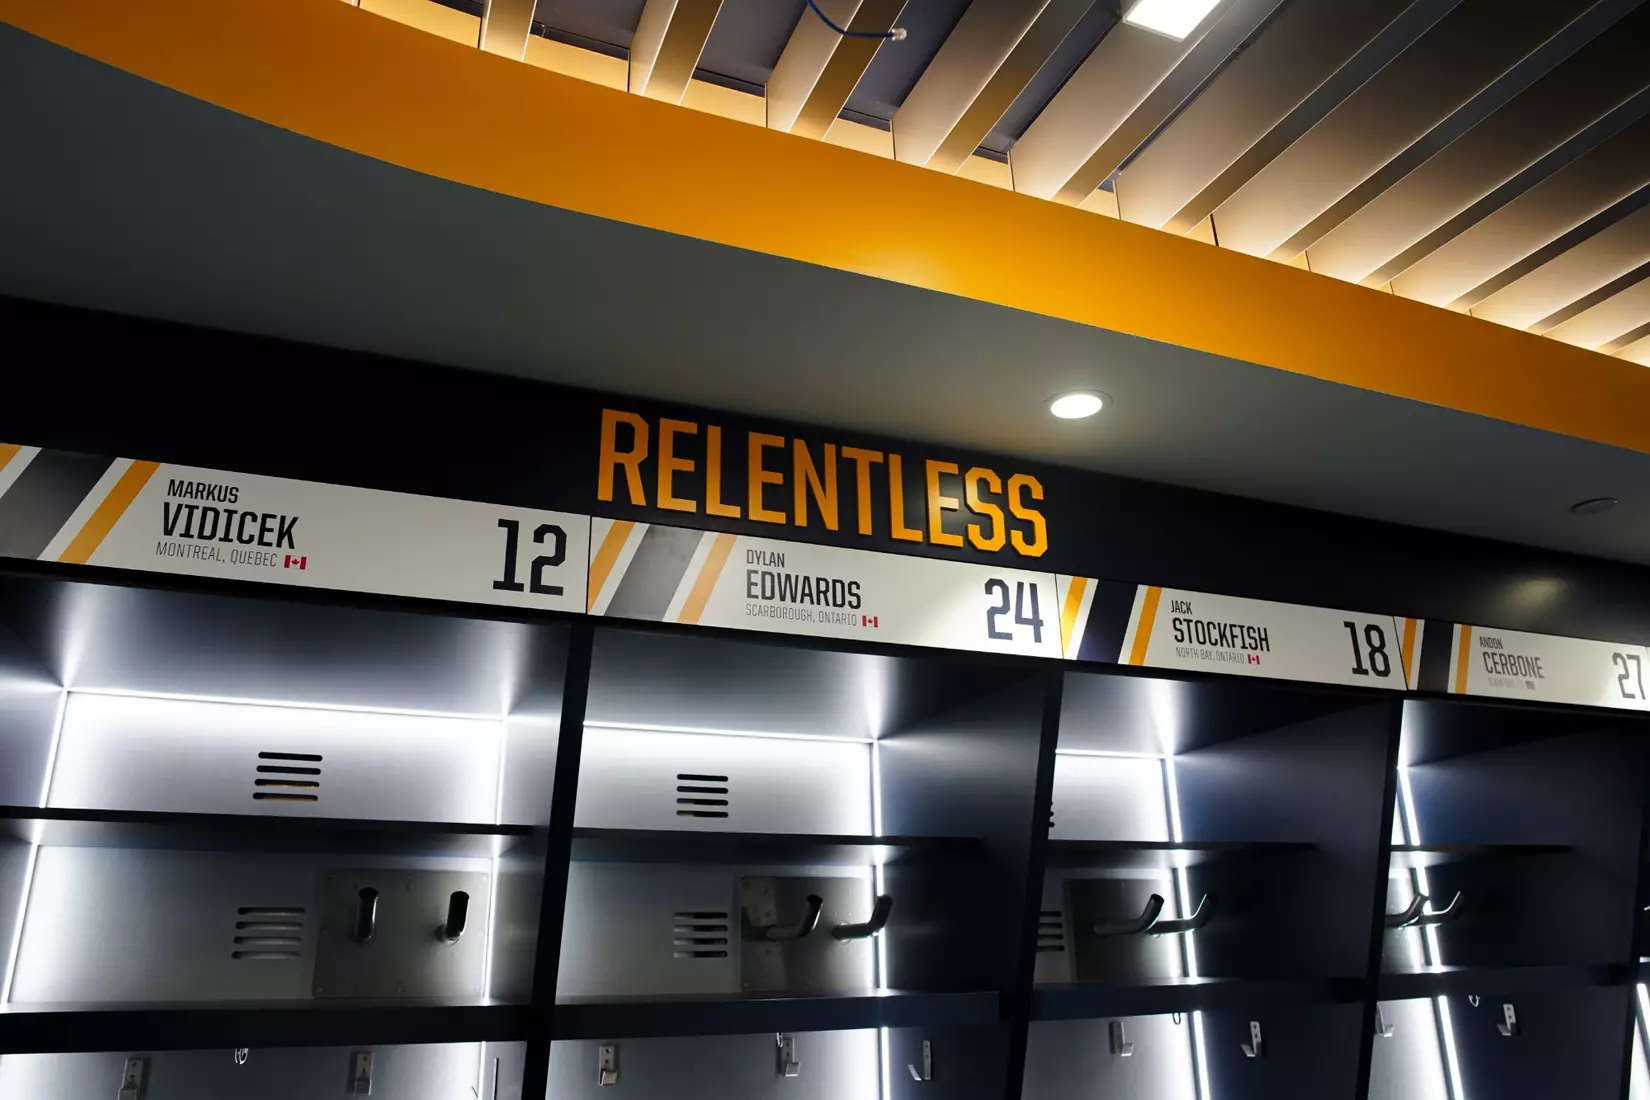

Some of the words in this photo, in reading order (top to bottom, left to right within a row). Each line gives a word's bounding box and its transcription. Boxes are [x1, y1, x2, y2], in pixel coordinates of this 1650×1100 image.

[167, 479, 239, 504] MARKUS
[597, 407, 1048, 558] RELENTLESS
[162, 501, 299, 549] VIDICEK
[155, 541, 226, 564] MONTREAL,
[230, 549, 278, 568] QUEBEC
[493, 518, 567, 596] 12
[746, 548, 785, 568] DYLAN
[746, 569, 862, 610] EDWARDS
[1171, 599, 1193, 615] JACK
[745, 603, 815, 623] SCARBOROUGH,
[818, 610, 858, 627] ONTARIO
[984, 577, 1044, 644] 24
[1172, 617, 1271, 652] STOCKFISH
[1343, 620, 1392, 678] 18
[1175, 646, 1200, 660] NORTH
[1215, 650, 1245, 665] ONTARIO
[1482, 651, 1545, 679] CERBONE
[1612, 652, 1646, 700] 27
